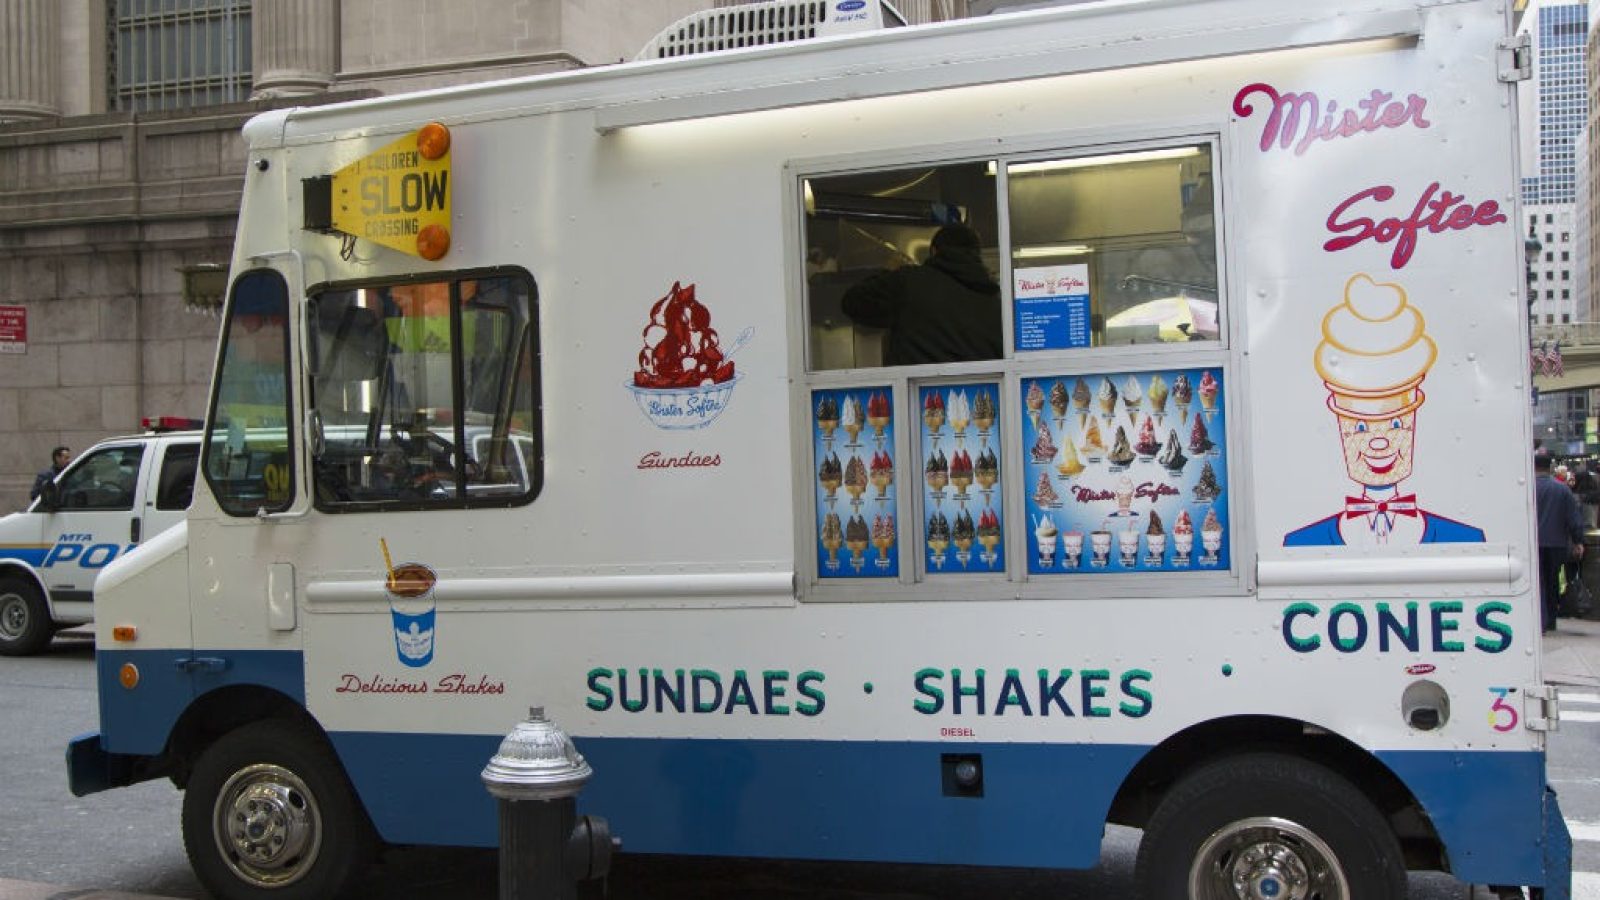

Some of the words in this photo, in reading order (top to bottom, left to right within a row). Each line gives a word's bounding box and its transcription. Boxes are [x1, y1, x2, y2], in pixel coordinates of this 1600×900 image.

[1233, 83, 1430, 156] Mister
[361, 170, 448, 216] SLOW
[365, 218, 418, 237] CROSSING
[1323, 182, 1507, 269] Softee
[637, 450, 721, 469] Sundaes
[1071, 484, 1116, 503] Mister
[1134, 482, 1180, 503] Softee
[58, 533, 92, 542] MTA
[1282, 601, 1513, 653] CONES
[336, 674, 428, 693] Delicious
[433, 674, 504, 694] Shakes
[586, 667, 826, 716] SUNDAES
[914, 667, 1153, 718] SHAKES
[940, 727, 976, 737] DIESEL
